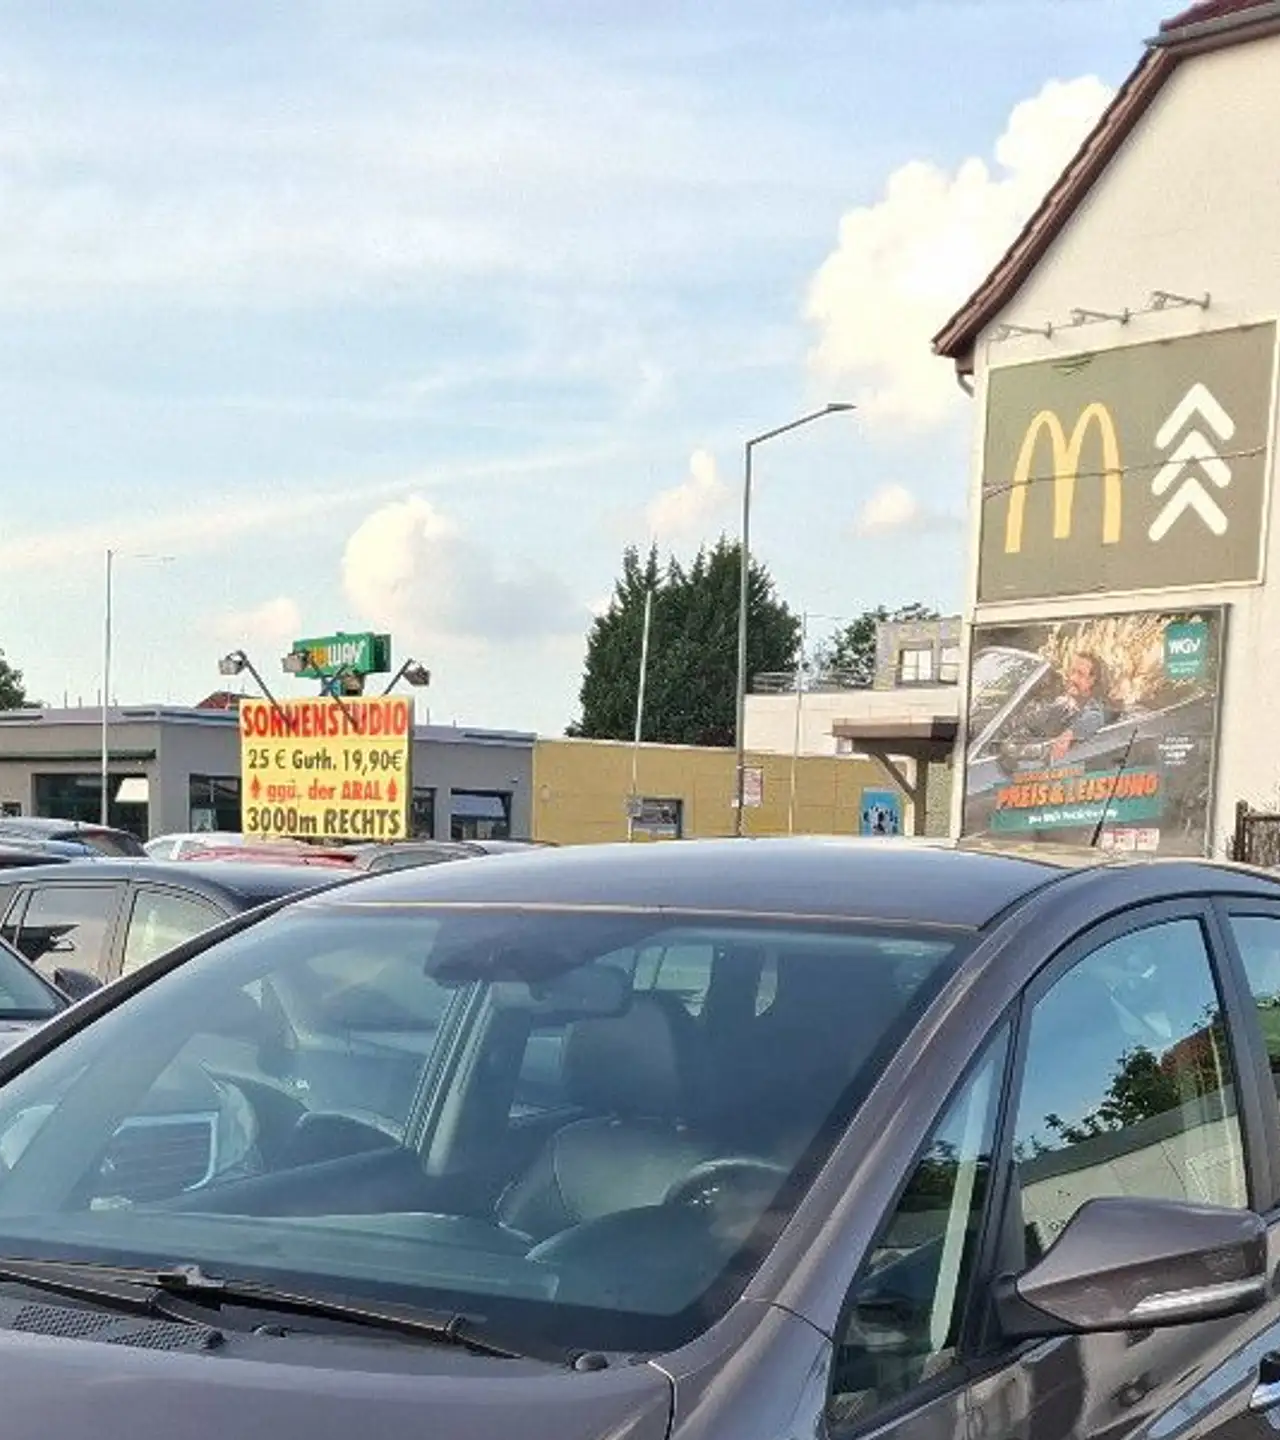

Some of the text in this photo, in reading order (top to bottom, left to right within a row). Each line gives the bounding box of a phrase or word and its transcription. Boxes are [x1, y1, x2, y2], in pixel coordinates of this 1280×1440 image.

[242, 701, 408, 738] SONNENSTUDIO
[248, 748, 403, 776] 25 € Guth. 19,90€
[308, 777, 336, 801] der
[341, 779, 383, 801] ARAL
[247, 807, 401, 836] 3000m RECHTS
